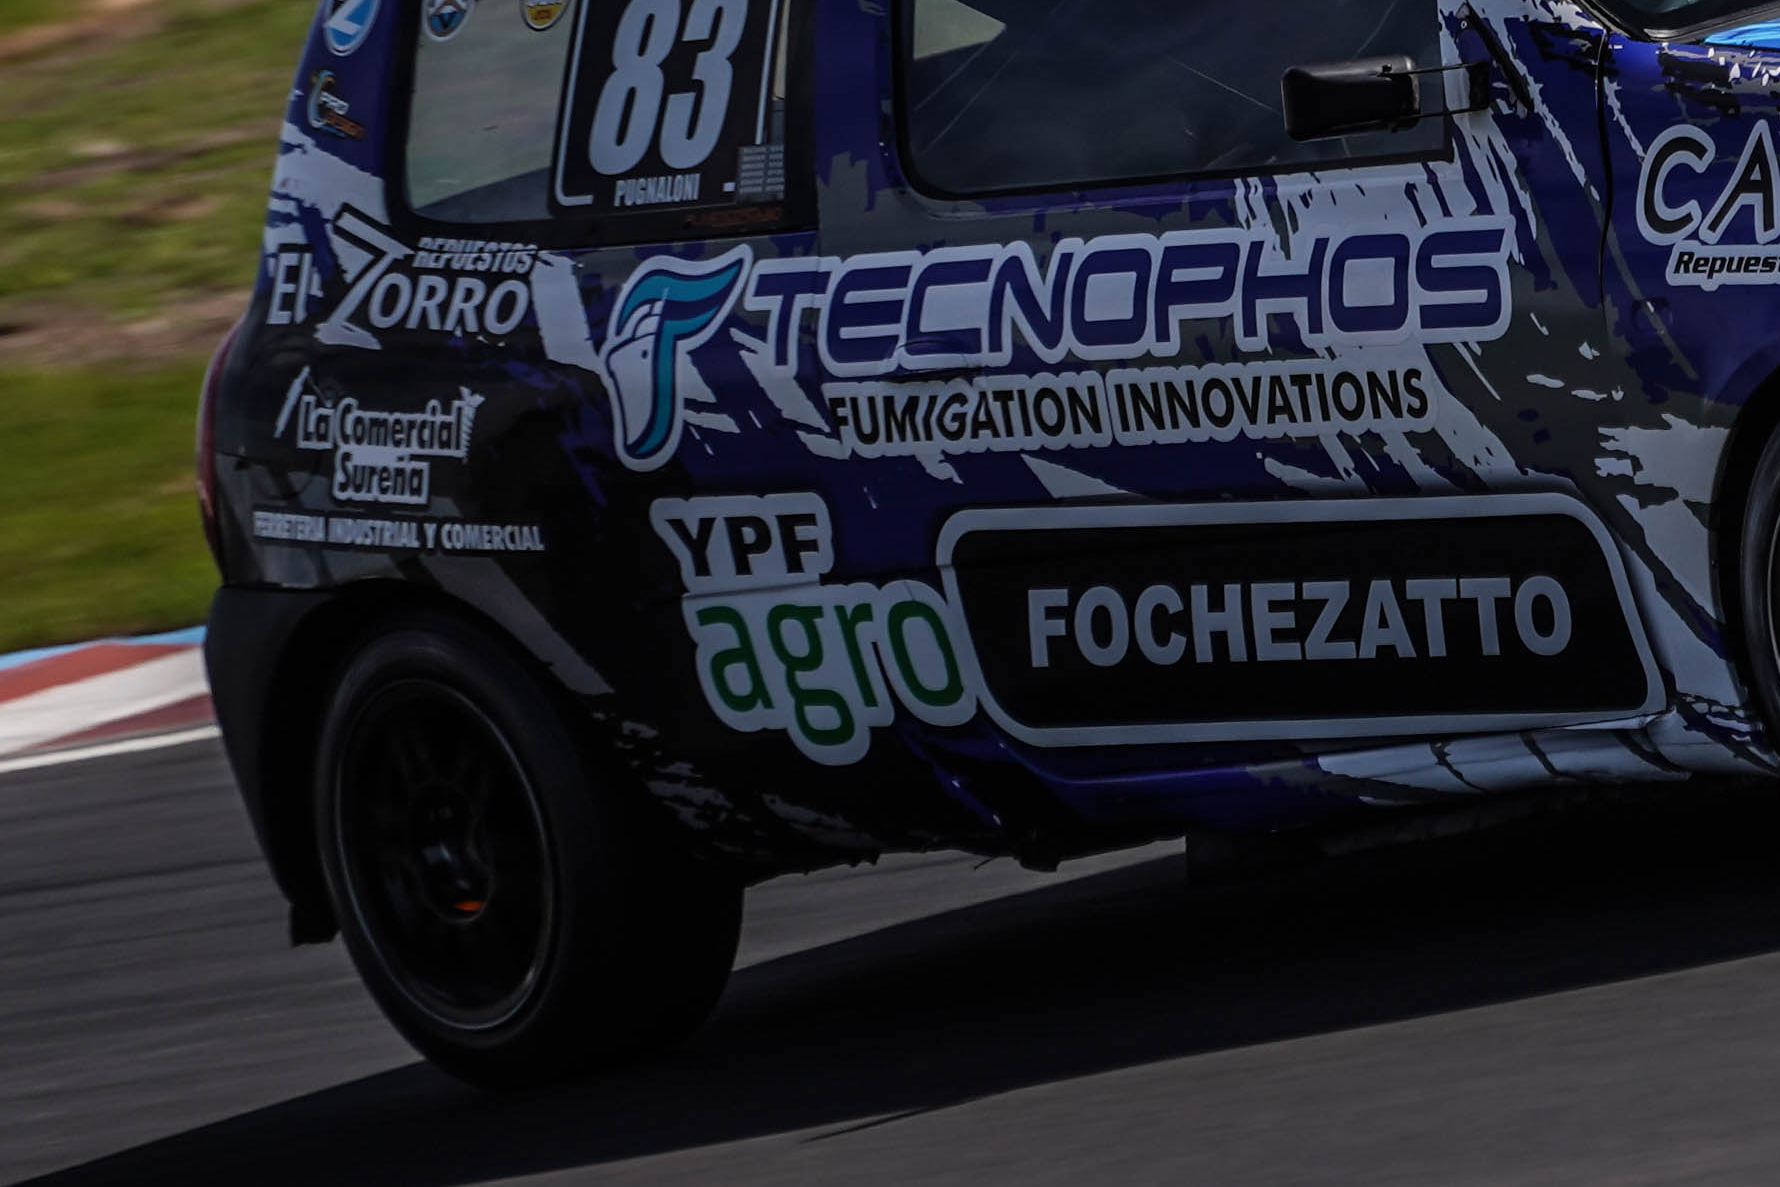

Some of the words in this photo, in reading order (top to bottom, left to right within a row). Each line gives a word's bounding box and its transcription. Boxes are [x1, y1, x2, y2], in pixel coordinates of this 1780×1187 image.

[613, 173, 700, 206] PUGNALONI
[313, 211, 530, 350] ZORRO
[751, 227, 1507, 367] TECNOPHOS
[302, 400, 332, 443] La
[338, 400, 463, 451] Comercial
[828, 375, 1102, 446] FUMIGATION
[1114, 369, 1430, 430] INNOVATIONS
[327, 516, 421, 549] INDUSTRIAL
[423, 522, 438, 549] Y
[440, 523, 546, 551] COMERCIAL
[668, 513, 820, 577] YPF
[1026, 576, 1573, 667] FOCHEZATTO
[695, 599, 965, 746] agro
